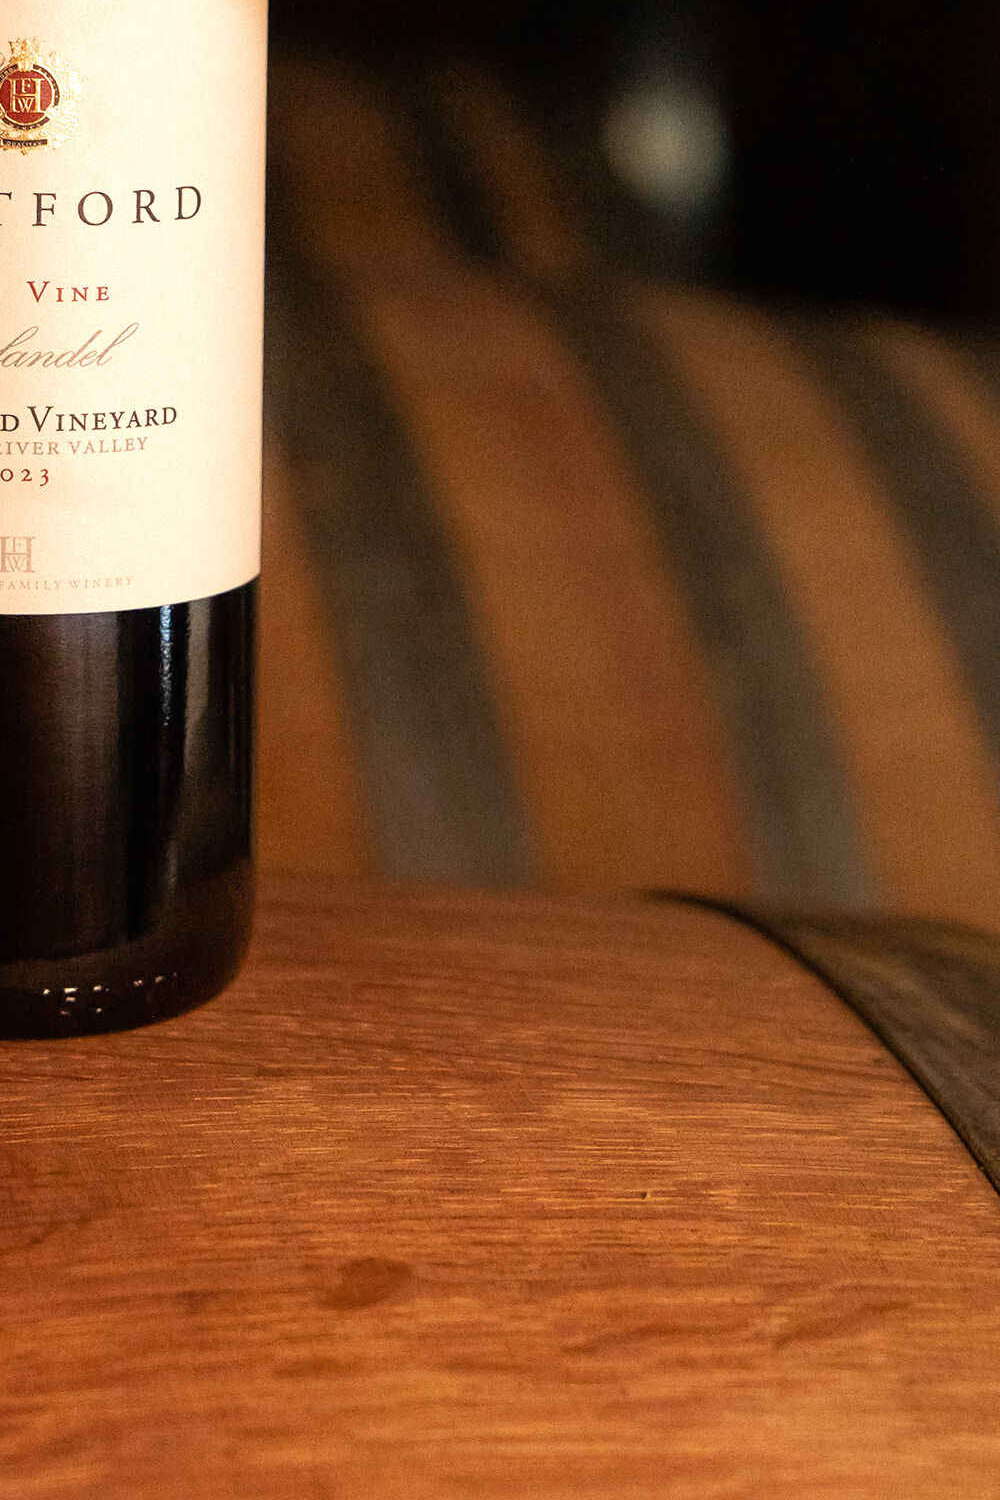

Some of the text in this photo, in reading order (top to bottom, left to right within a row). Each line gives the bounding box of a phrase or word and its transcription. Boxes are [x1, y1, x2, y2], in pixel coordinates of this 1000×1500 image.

[26, 280, 110, 303] VINE
[26, 405, 178, 433] VINEYARD
[68, 435, 149, 455] VALLEY
[68, 575, 134, 590] WINERY
